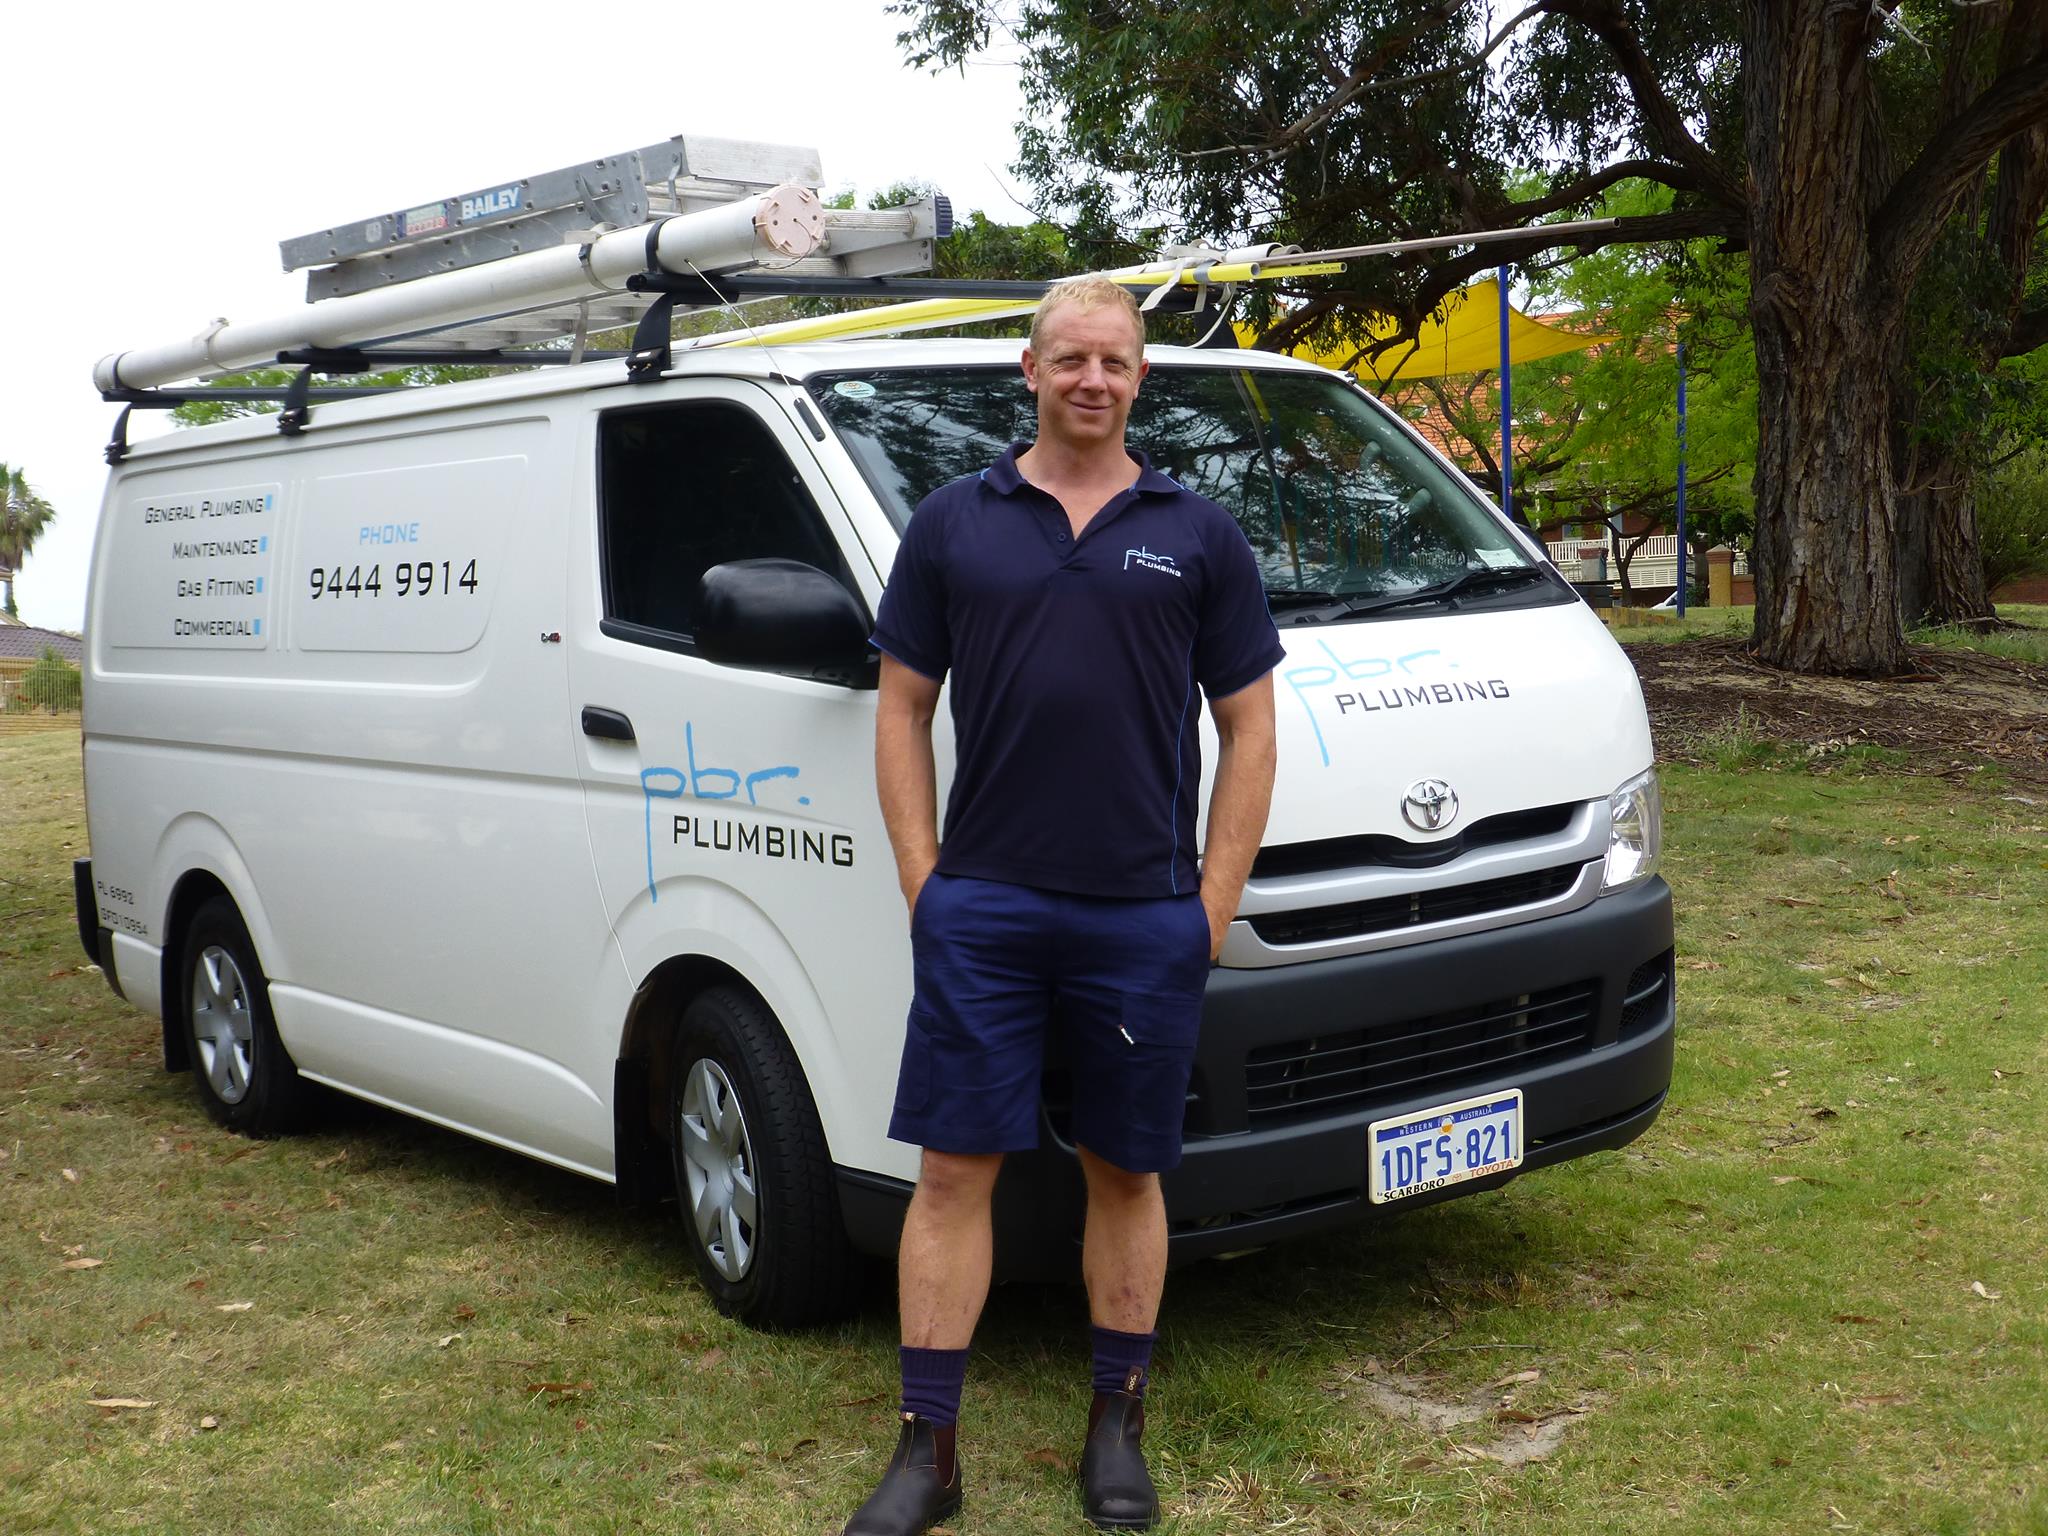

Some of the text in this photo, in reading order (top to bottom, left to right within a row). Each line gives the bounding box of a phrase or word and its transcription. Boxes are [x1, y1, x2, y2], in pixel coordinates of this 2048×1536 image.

[461, 187, 519, 220] BAILEY
[145, 498, 263, 523] GENERAL PLUMBING
[359, 522, 419, 545] PHONE
[172, 539, 258, 559] MAINTENANCE
[310, 558, 478, 600] 9444 9914
[1136, 558, 1182, 577] PLUMBING
[177, 578, 254, 597] GAS FITTING
[174, 618, 251, 636] COMMERCIAL
[1335, 679, 1511, 714] PLUMBING
[673, 815, 854, 867] PLUMBING
[1460, 1106, 1492, 1121] AUSTRALIA
[1384, 1159, 1514, 1201] SCARBORO TOYOTA
